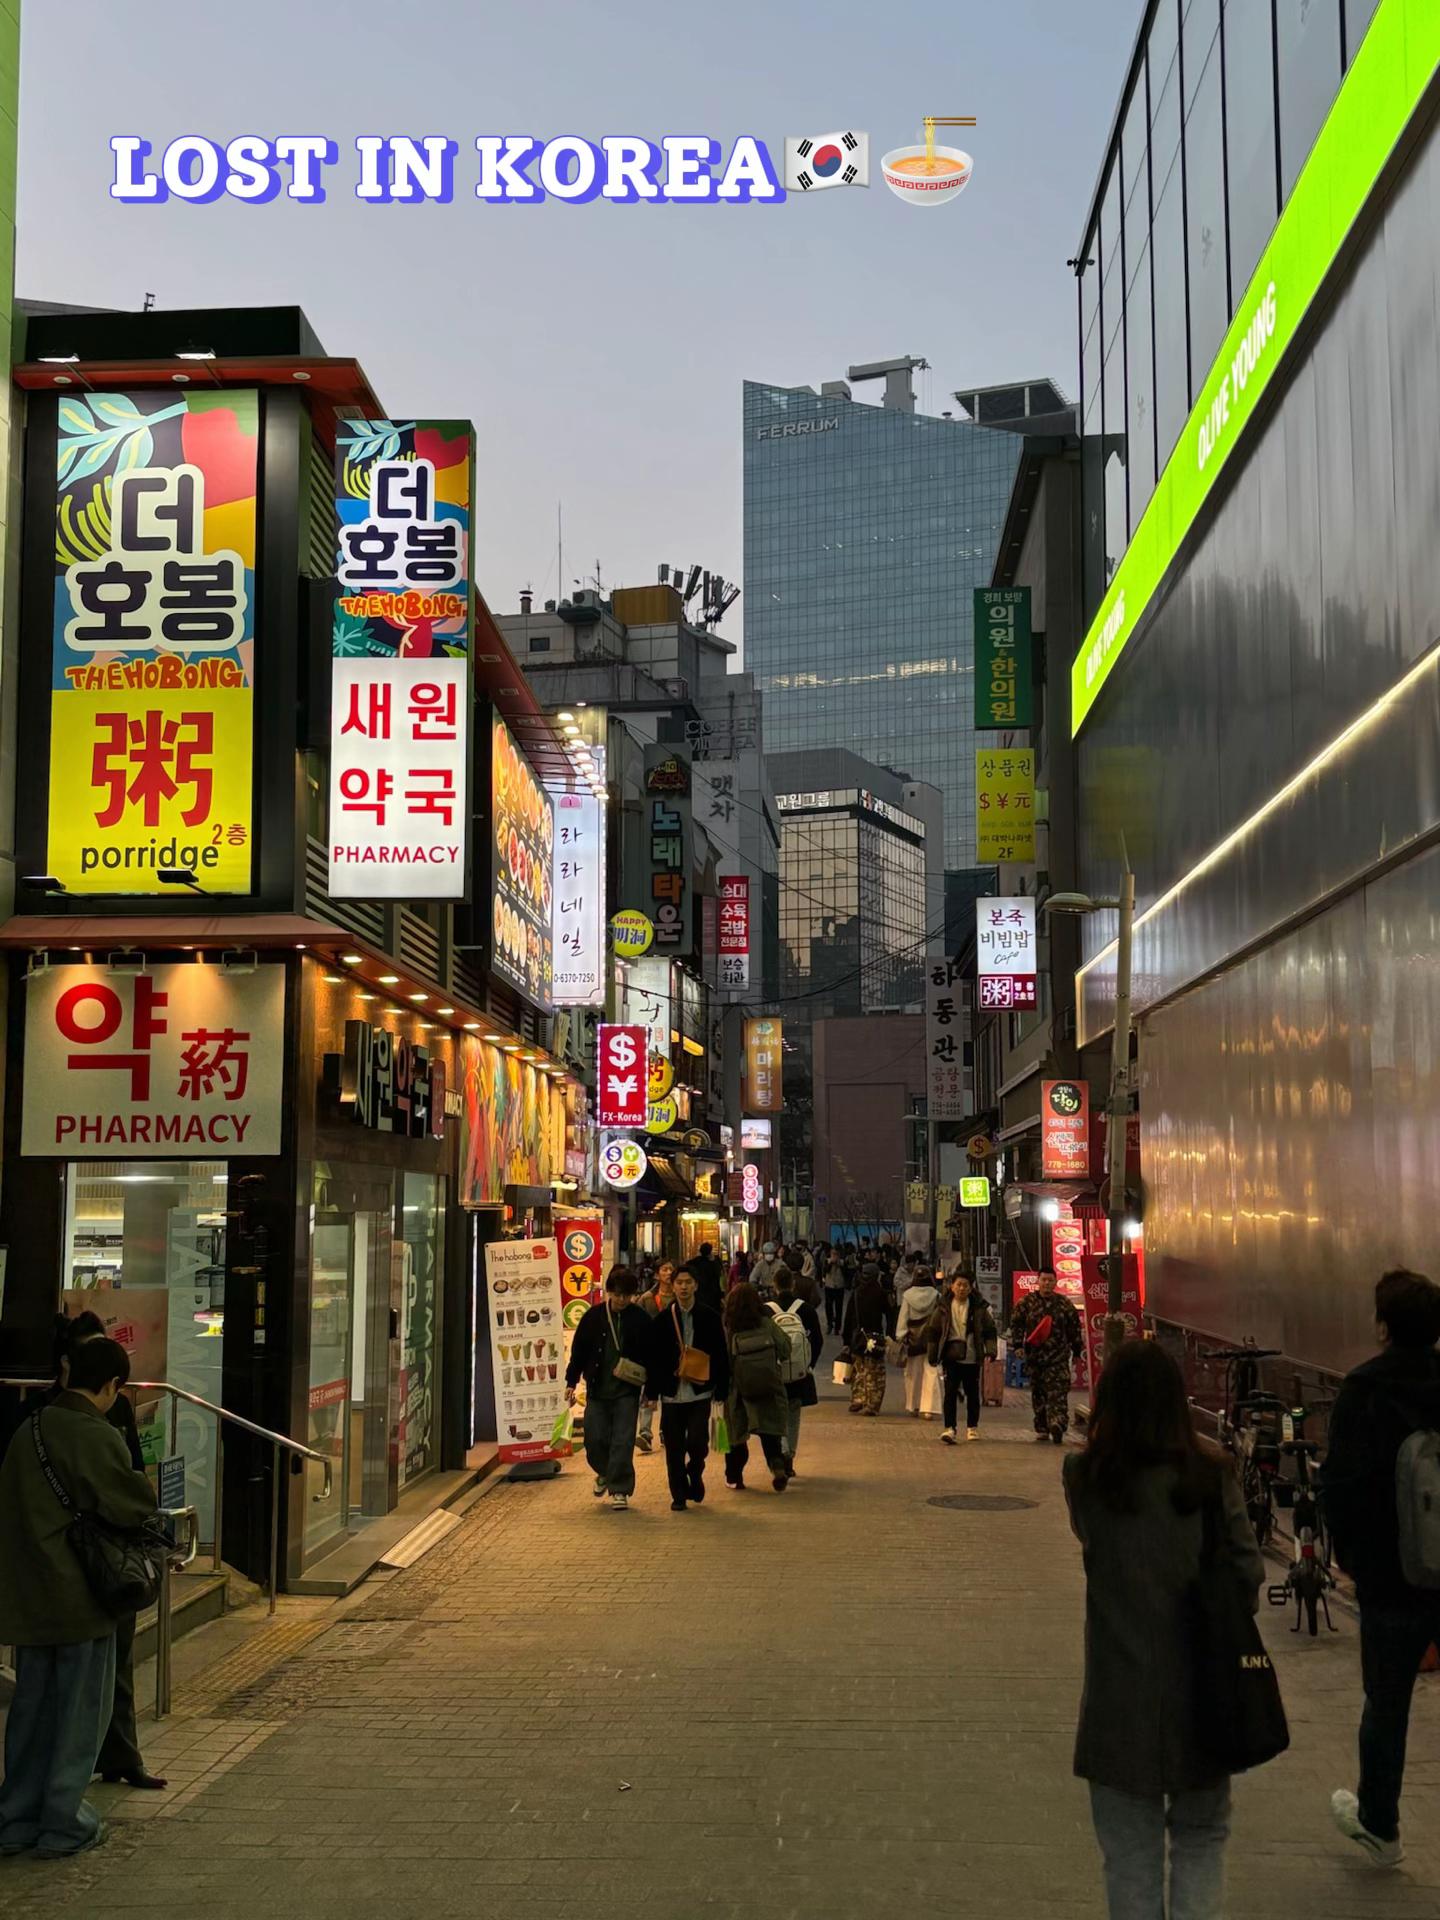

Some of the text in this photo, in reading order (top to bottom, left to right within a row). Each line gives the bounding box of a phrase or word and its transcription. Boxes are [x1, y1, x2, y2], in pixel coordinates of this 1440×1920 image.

[1197, 281, 1277, 472] OLIVE YOUNG
[757, 417, 840, 441] FERRUM
[120, 472, 196, 555] 더
[378, 466, 430, 521] 더
[344, 525, 459, 583] 호봉
[73, 559, 238, 641] 호봉
[988, 605, 1015, 648] 의원
[989, 656, 1018, 722] 한의원
[340, 682, 457, 741] 새원
[91, 709, 215, 830] 粥
[981, 758, 1031, 778] 상품권
[339, 767, 457, 827] 약국
[979, 793, 990, 811] $
[1014, 793, 1031, 809] 元
[81, 838, 220, 874] porridge
[333, 845, 460, 864] PHARMACY
[651, 800, 685, 945] 노래타운
[998, 847, 1014, 859] 2F
[560, 827, 585, 957] 라라네일
[987, 908, 1027, 927] 본죽
[980, 929, 1033, 950] 비빔밥
[930, 961, 958, 1063] 하동관
[55, 975, 169, 1102] 약
[608, 1032, 637, 1070] $
[607, 1074, 638, 1107] ¥
[55, 1114, 252, 1144] PHARMACY
[602, 1111, 642, 1122] FX-Korea
[570, 1232, 588, 1259] $
[569, 1271, 588, 1292] ¥
